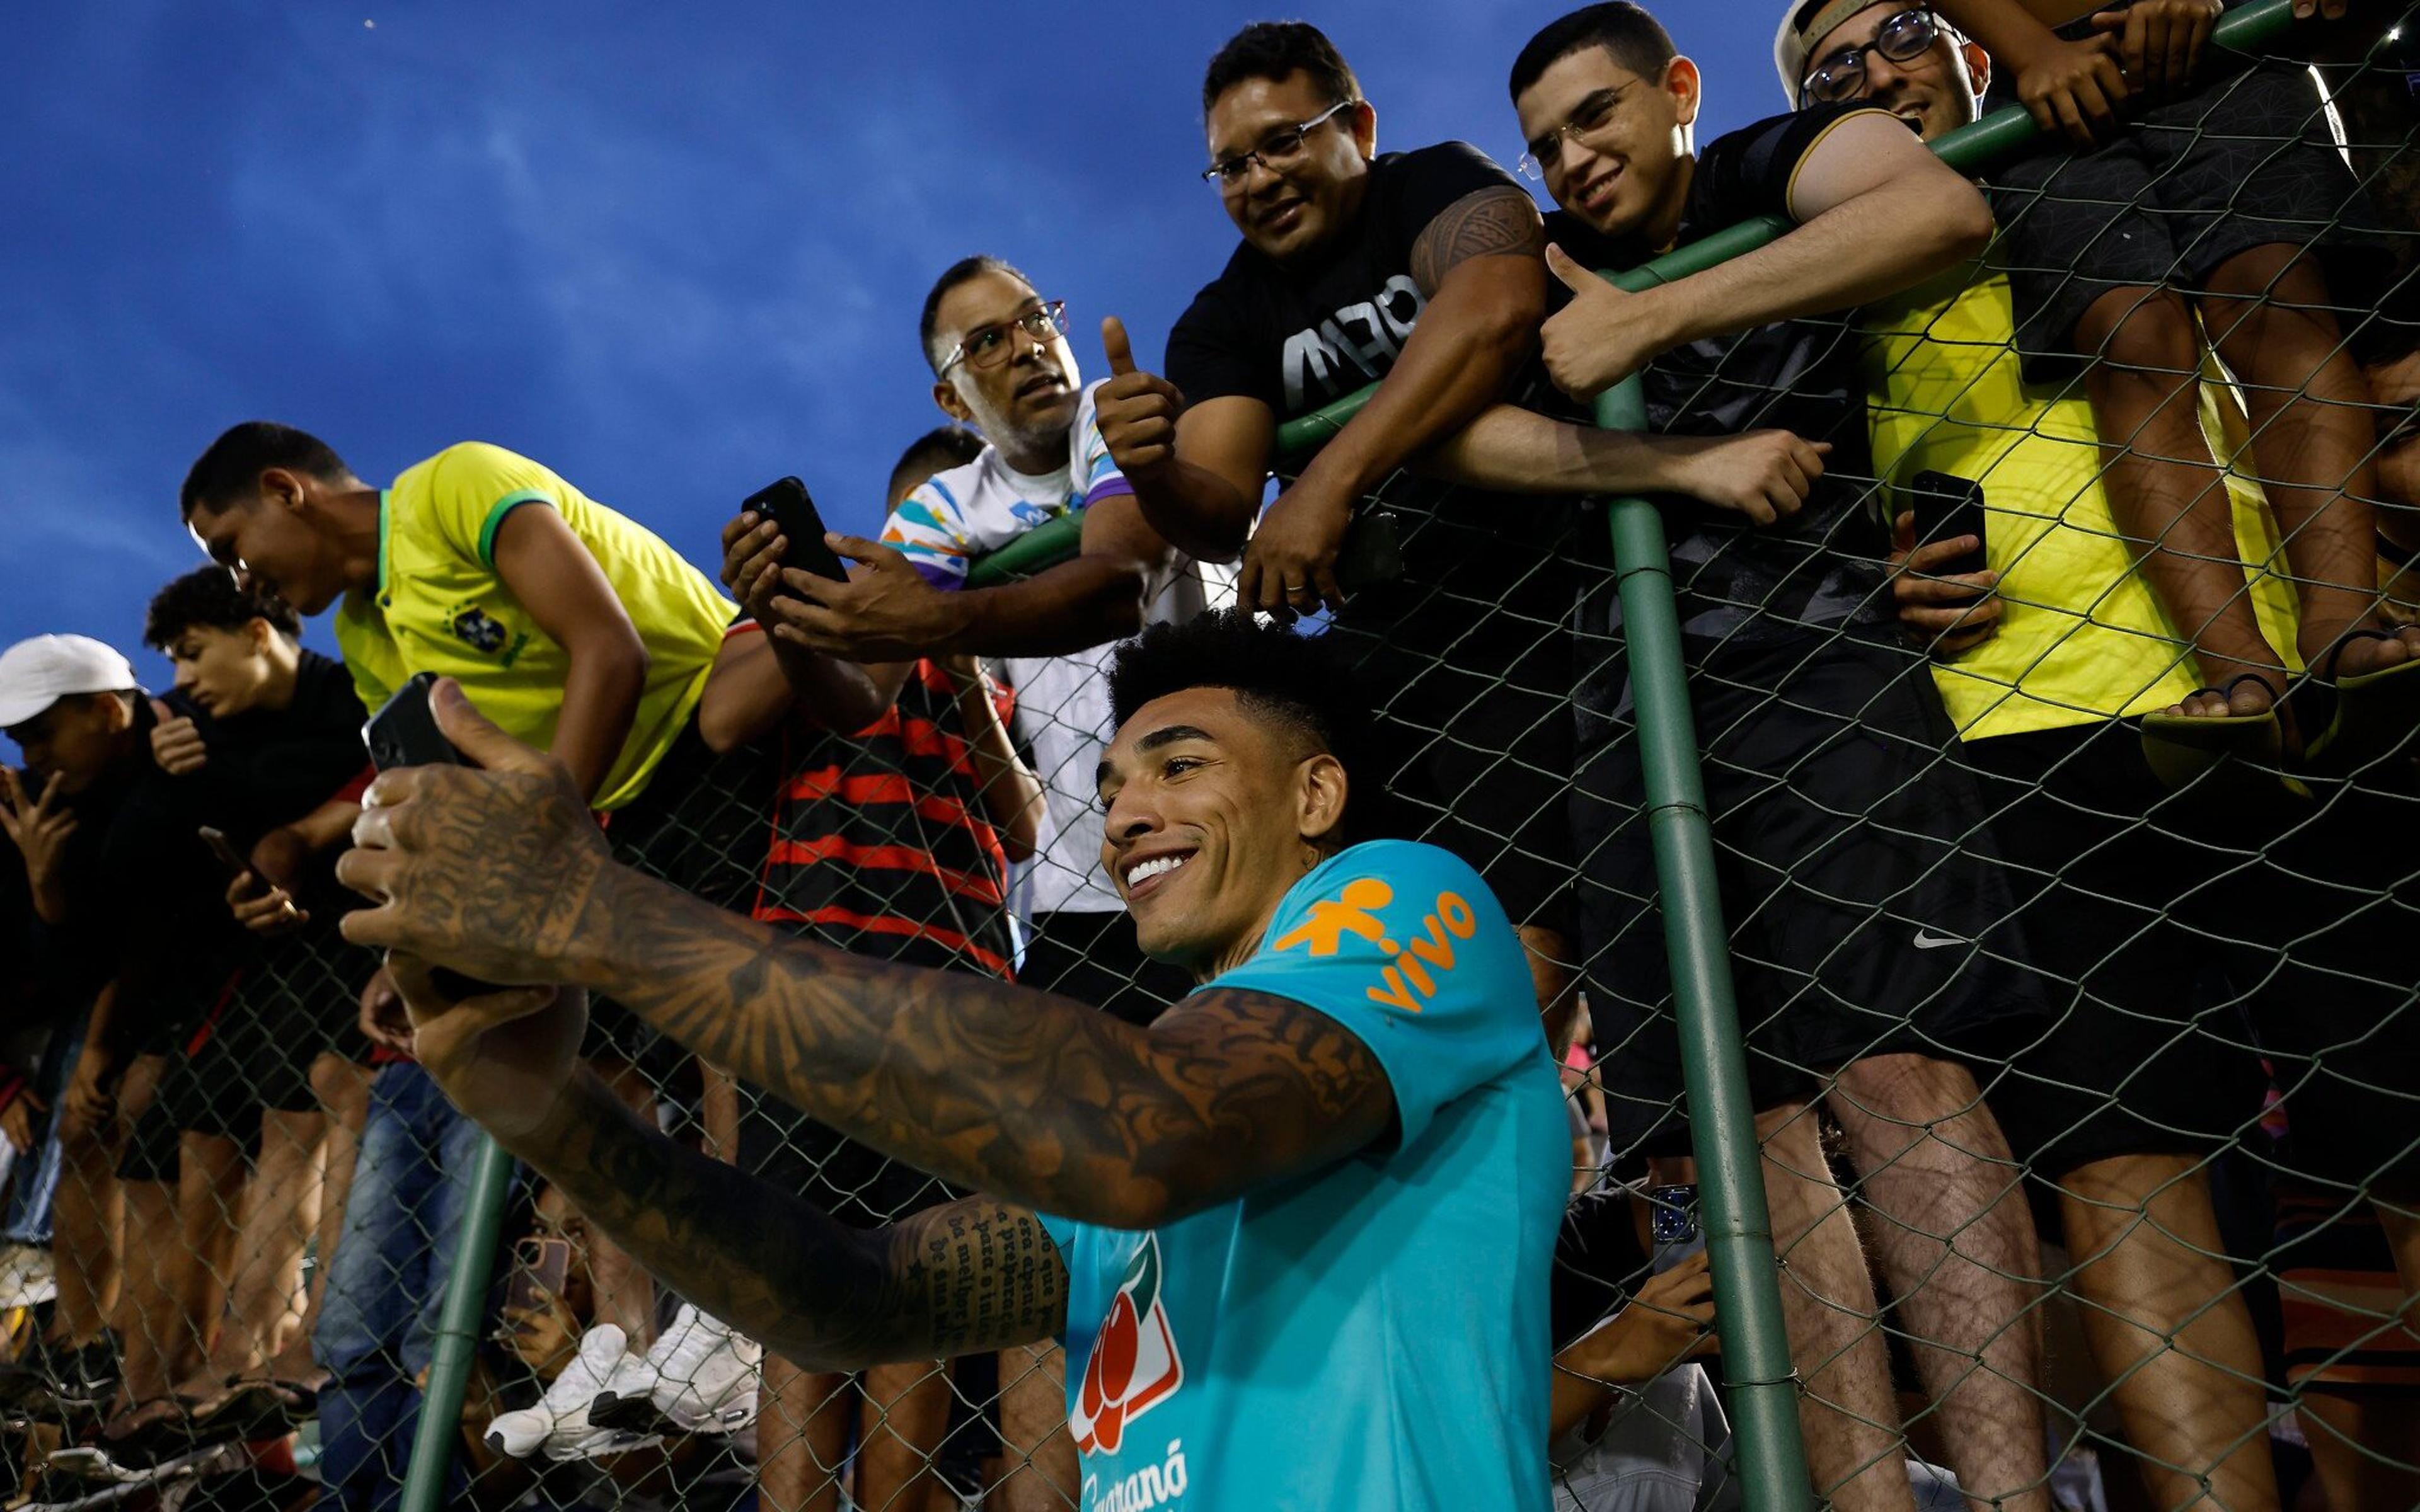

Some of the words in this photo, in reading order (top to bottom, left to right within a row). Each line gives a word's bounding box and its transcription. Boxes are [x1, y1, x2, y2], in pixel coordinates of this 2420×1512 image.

[1366, 891, 1475, 1012] vivo
[1018, 1217, 1032, 1249] era
[1040, 1259, 1054, 1297] que
